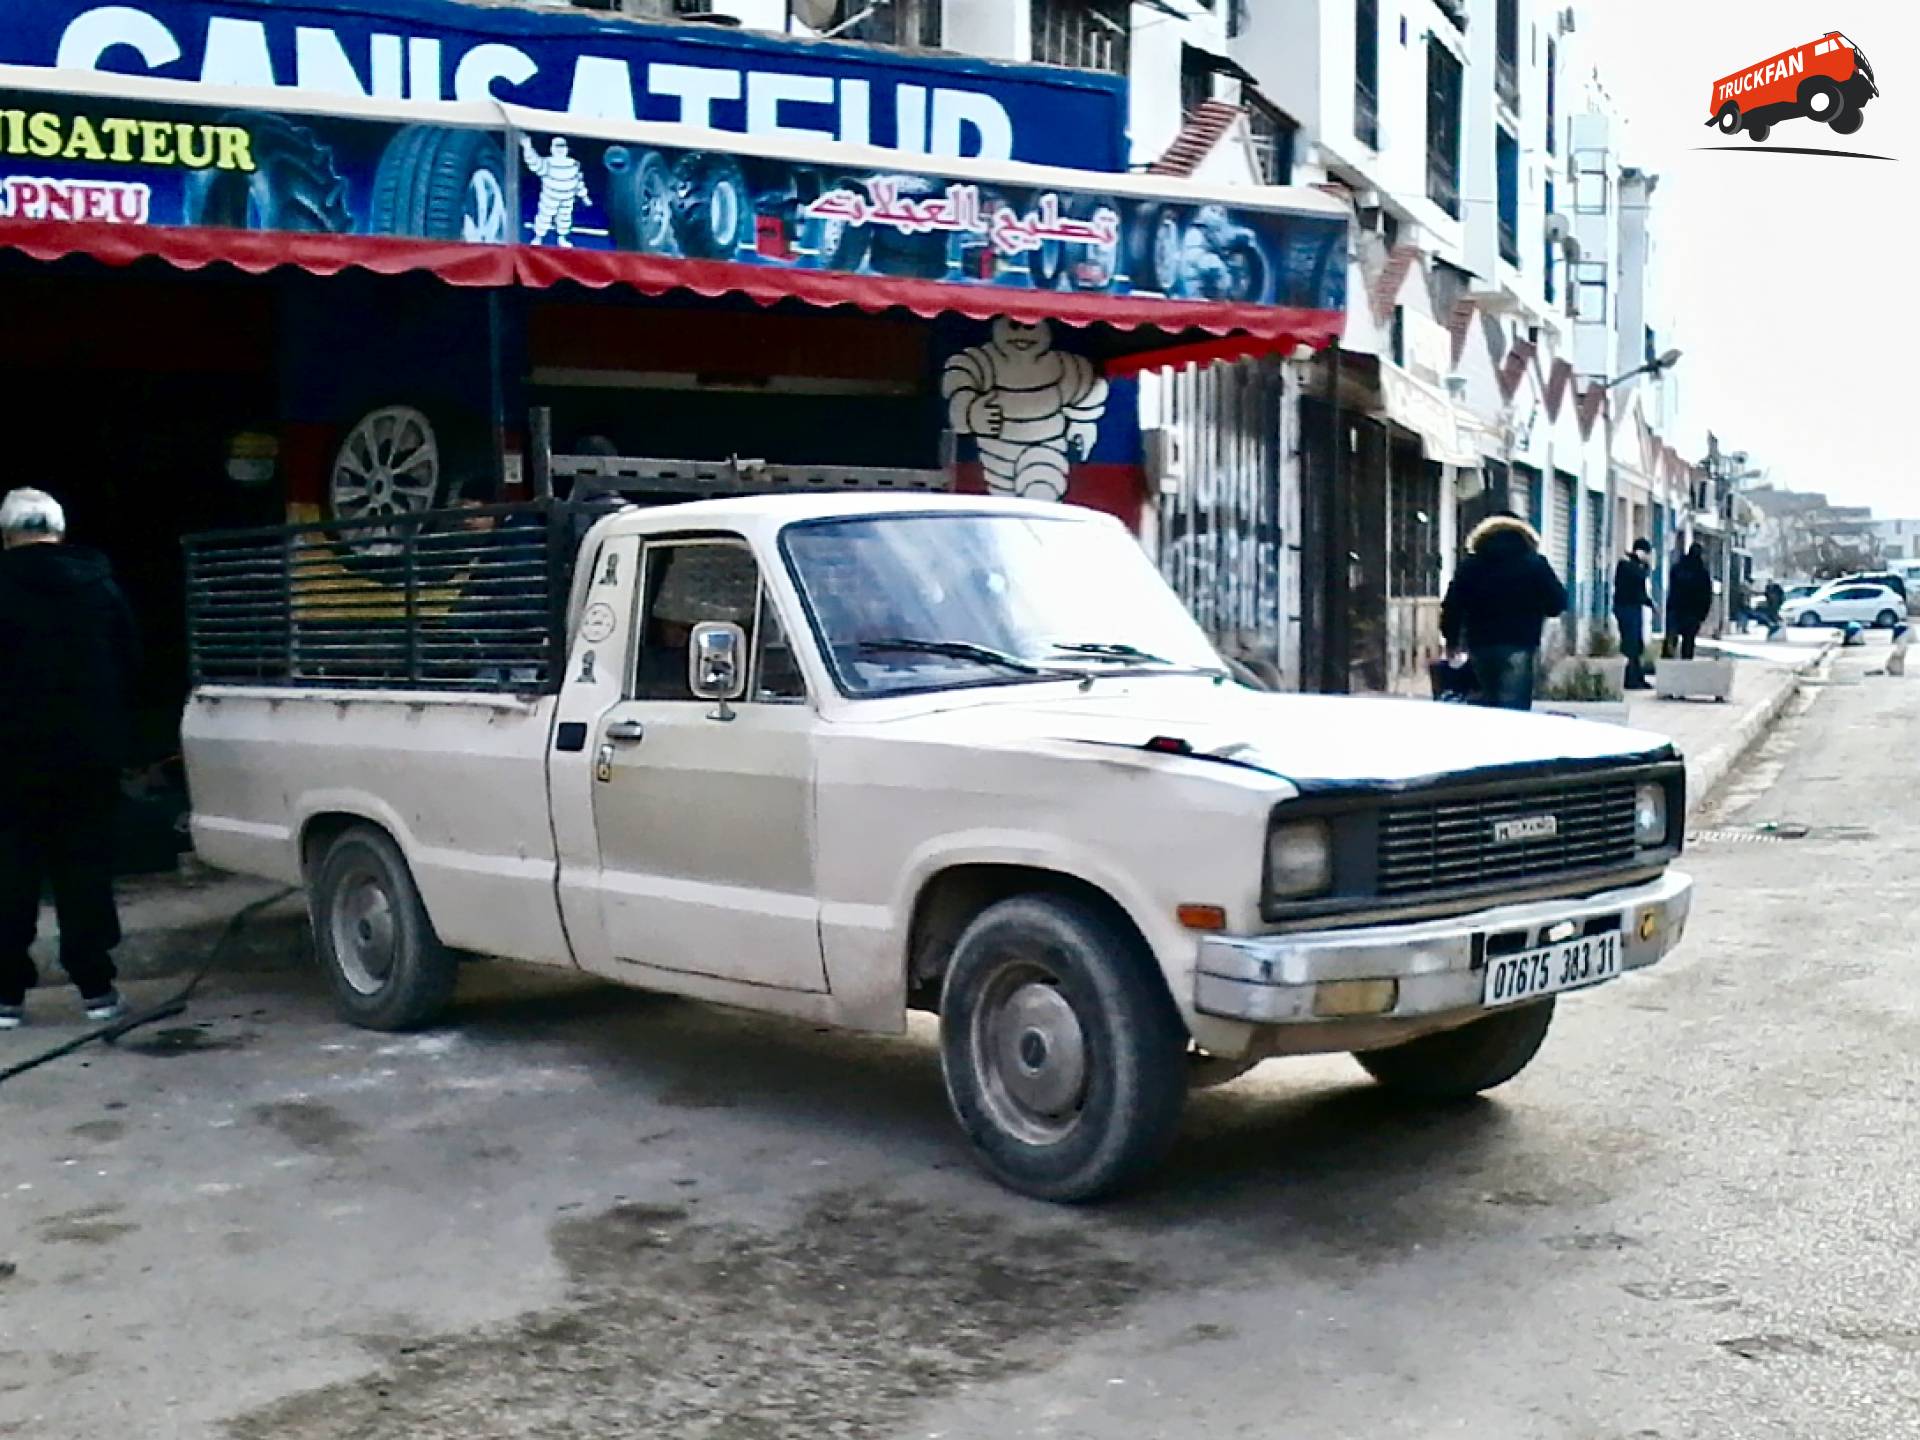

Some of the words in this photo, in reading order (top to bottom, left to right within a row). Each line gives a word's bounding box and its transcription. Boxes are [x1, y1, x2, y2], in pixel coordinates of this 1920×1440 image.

[0, 109, 255, 171] ISATEUR
[806, 177, 987, 233] العجلات
[991, 195, 1118, 252] تصليح
[1494, 951, 1550, 999] 07675
[1560, 942, 1591, 985] 383
